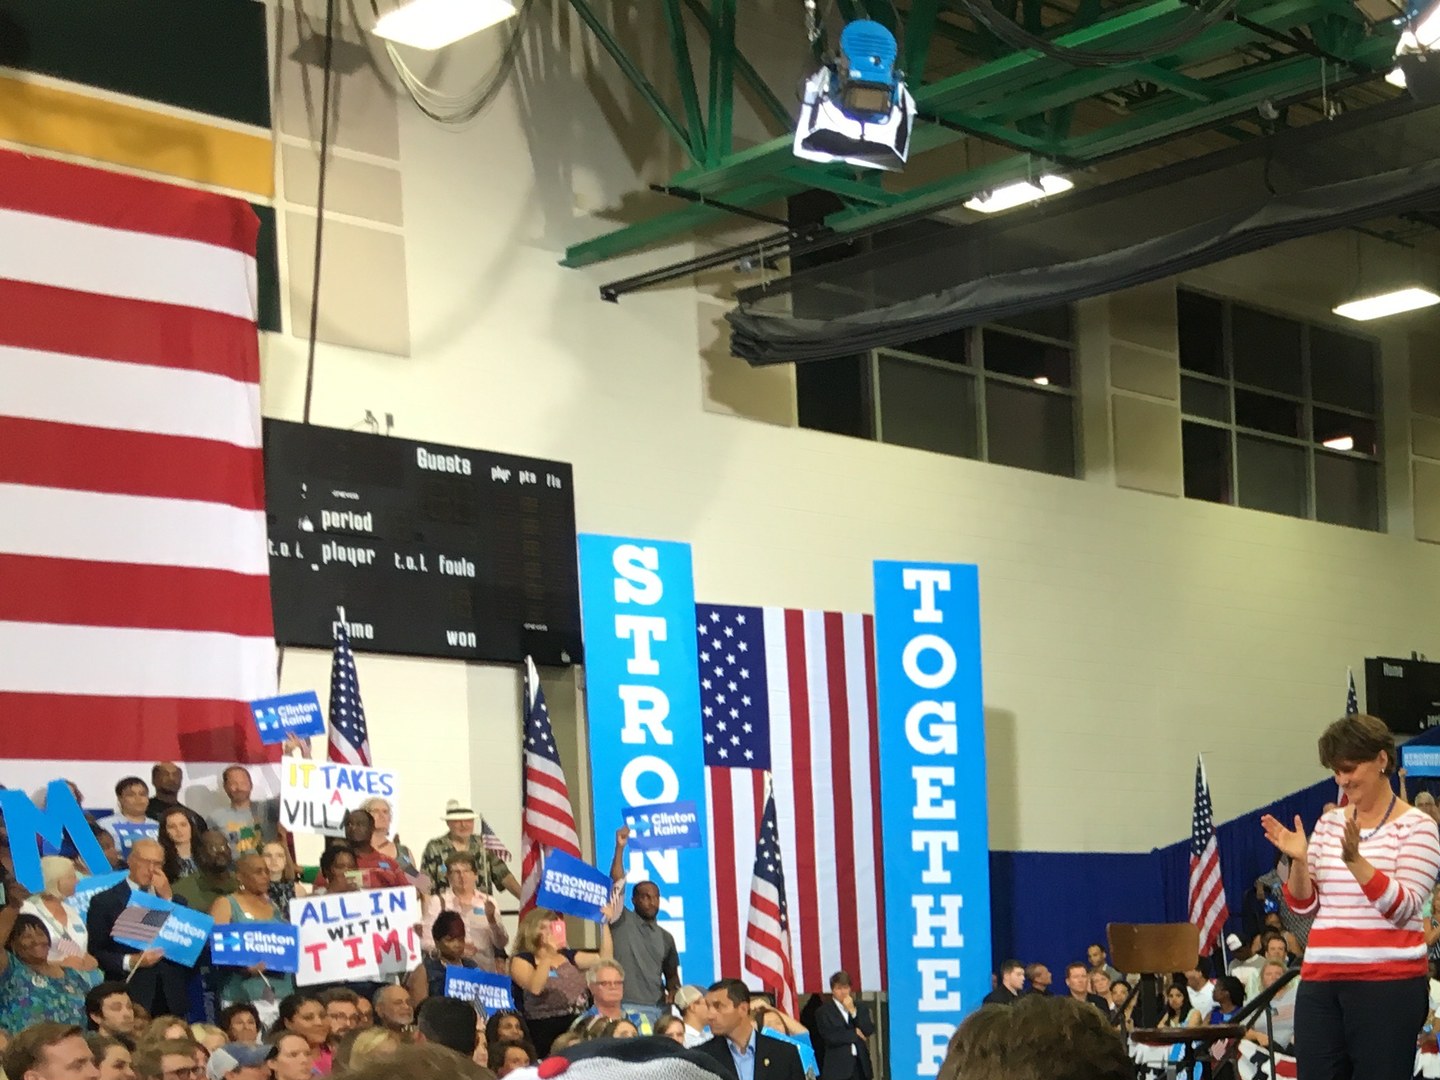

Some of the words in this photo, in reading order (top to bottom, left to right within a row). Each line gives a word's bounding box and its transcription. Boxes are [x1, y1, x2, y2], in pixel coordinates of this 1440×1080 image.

[416, 447, 472, 476] Guests
[321, 510, 373, 532] period
[322, 540, 376, 568] player
[438, 554, 475, 578] fouls
[446, 630, 477, 648] won
[278, 703, 318, 716] Clinton
[281, 713, 313, 728] Kaine
[289, 763, 316, 788] IT
[320, 766, 394, 796] TAKES
[330, 790, 343, 805] A
[650, 812, 696, 825] Clinton
[653, 823, 689, 836] Kaine
[902, 568, 964, 1076] TOGETHER
[544, 880, 607, 907] TOGETHER
[546, 869, 608, 898] STRONGER
[300, 896, 362, 926] ALL
[369, 891, 406, 915] IN
[165, 913, 206, 940] linton
[327, 916, 390, 942] WITH
[159, 929, 193, 948] aine
[243, 931, 295, 946] Clinton
[245, 942, 286, 955] Kaine
[304, 926, 417, 973] TIM!
[449, 978, 509, 999] STRONGER
